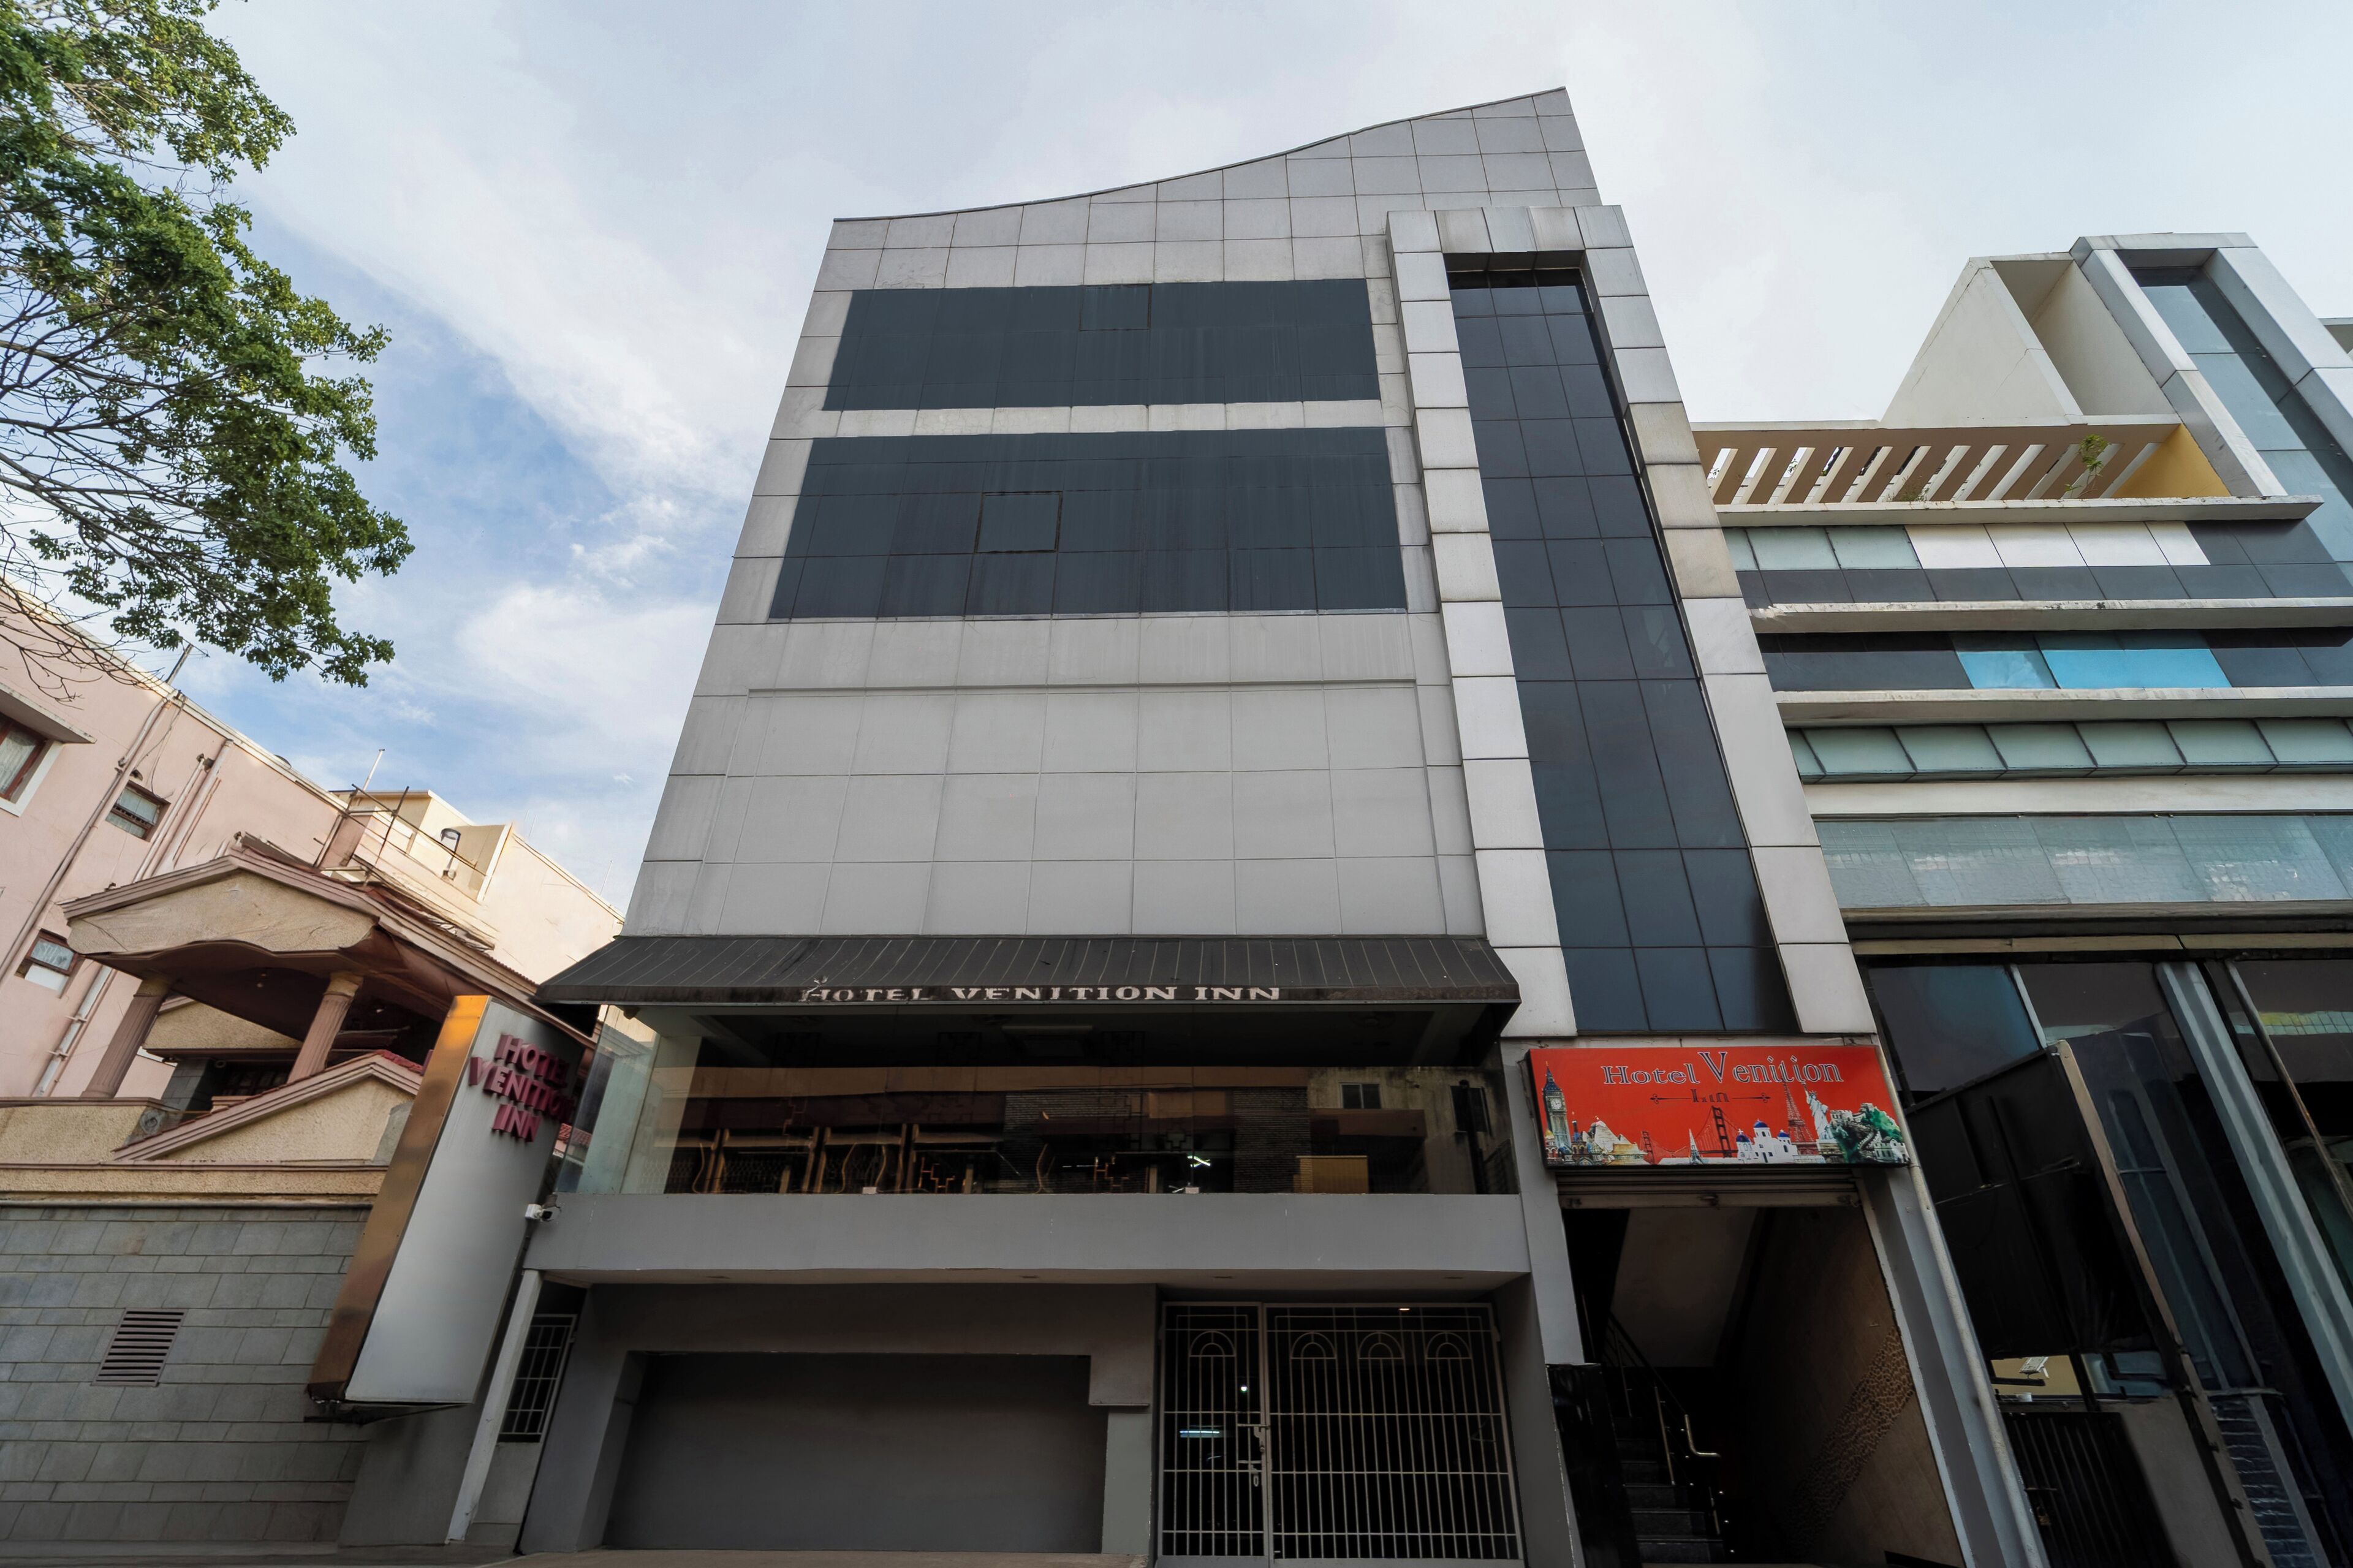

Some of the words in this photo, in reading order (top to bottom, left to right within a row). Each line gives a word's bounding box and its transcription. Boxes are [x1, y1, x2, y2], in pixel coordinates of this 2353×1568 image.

[799, 987, 932, 1002] HOTEL
[952, 987, 1176, 1001] VENITION
[1195, 987, 1280, 1001] INN
[1601, 1064, 1700, 1084] Hotel
[1698, 1051, 1844, 1083] Venition
[492, 1104, 542, 1142] INN
